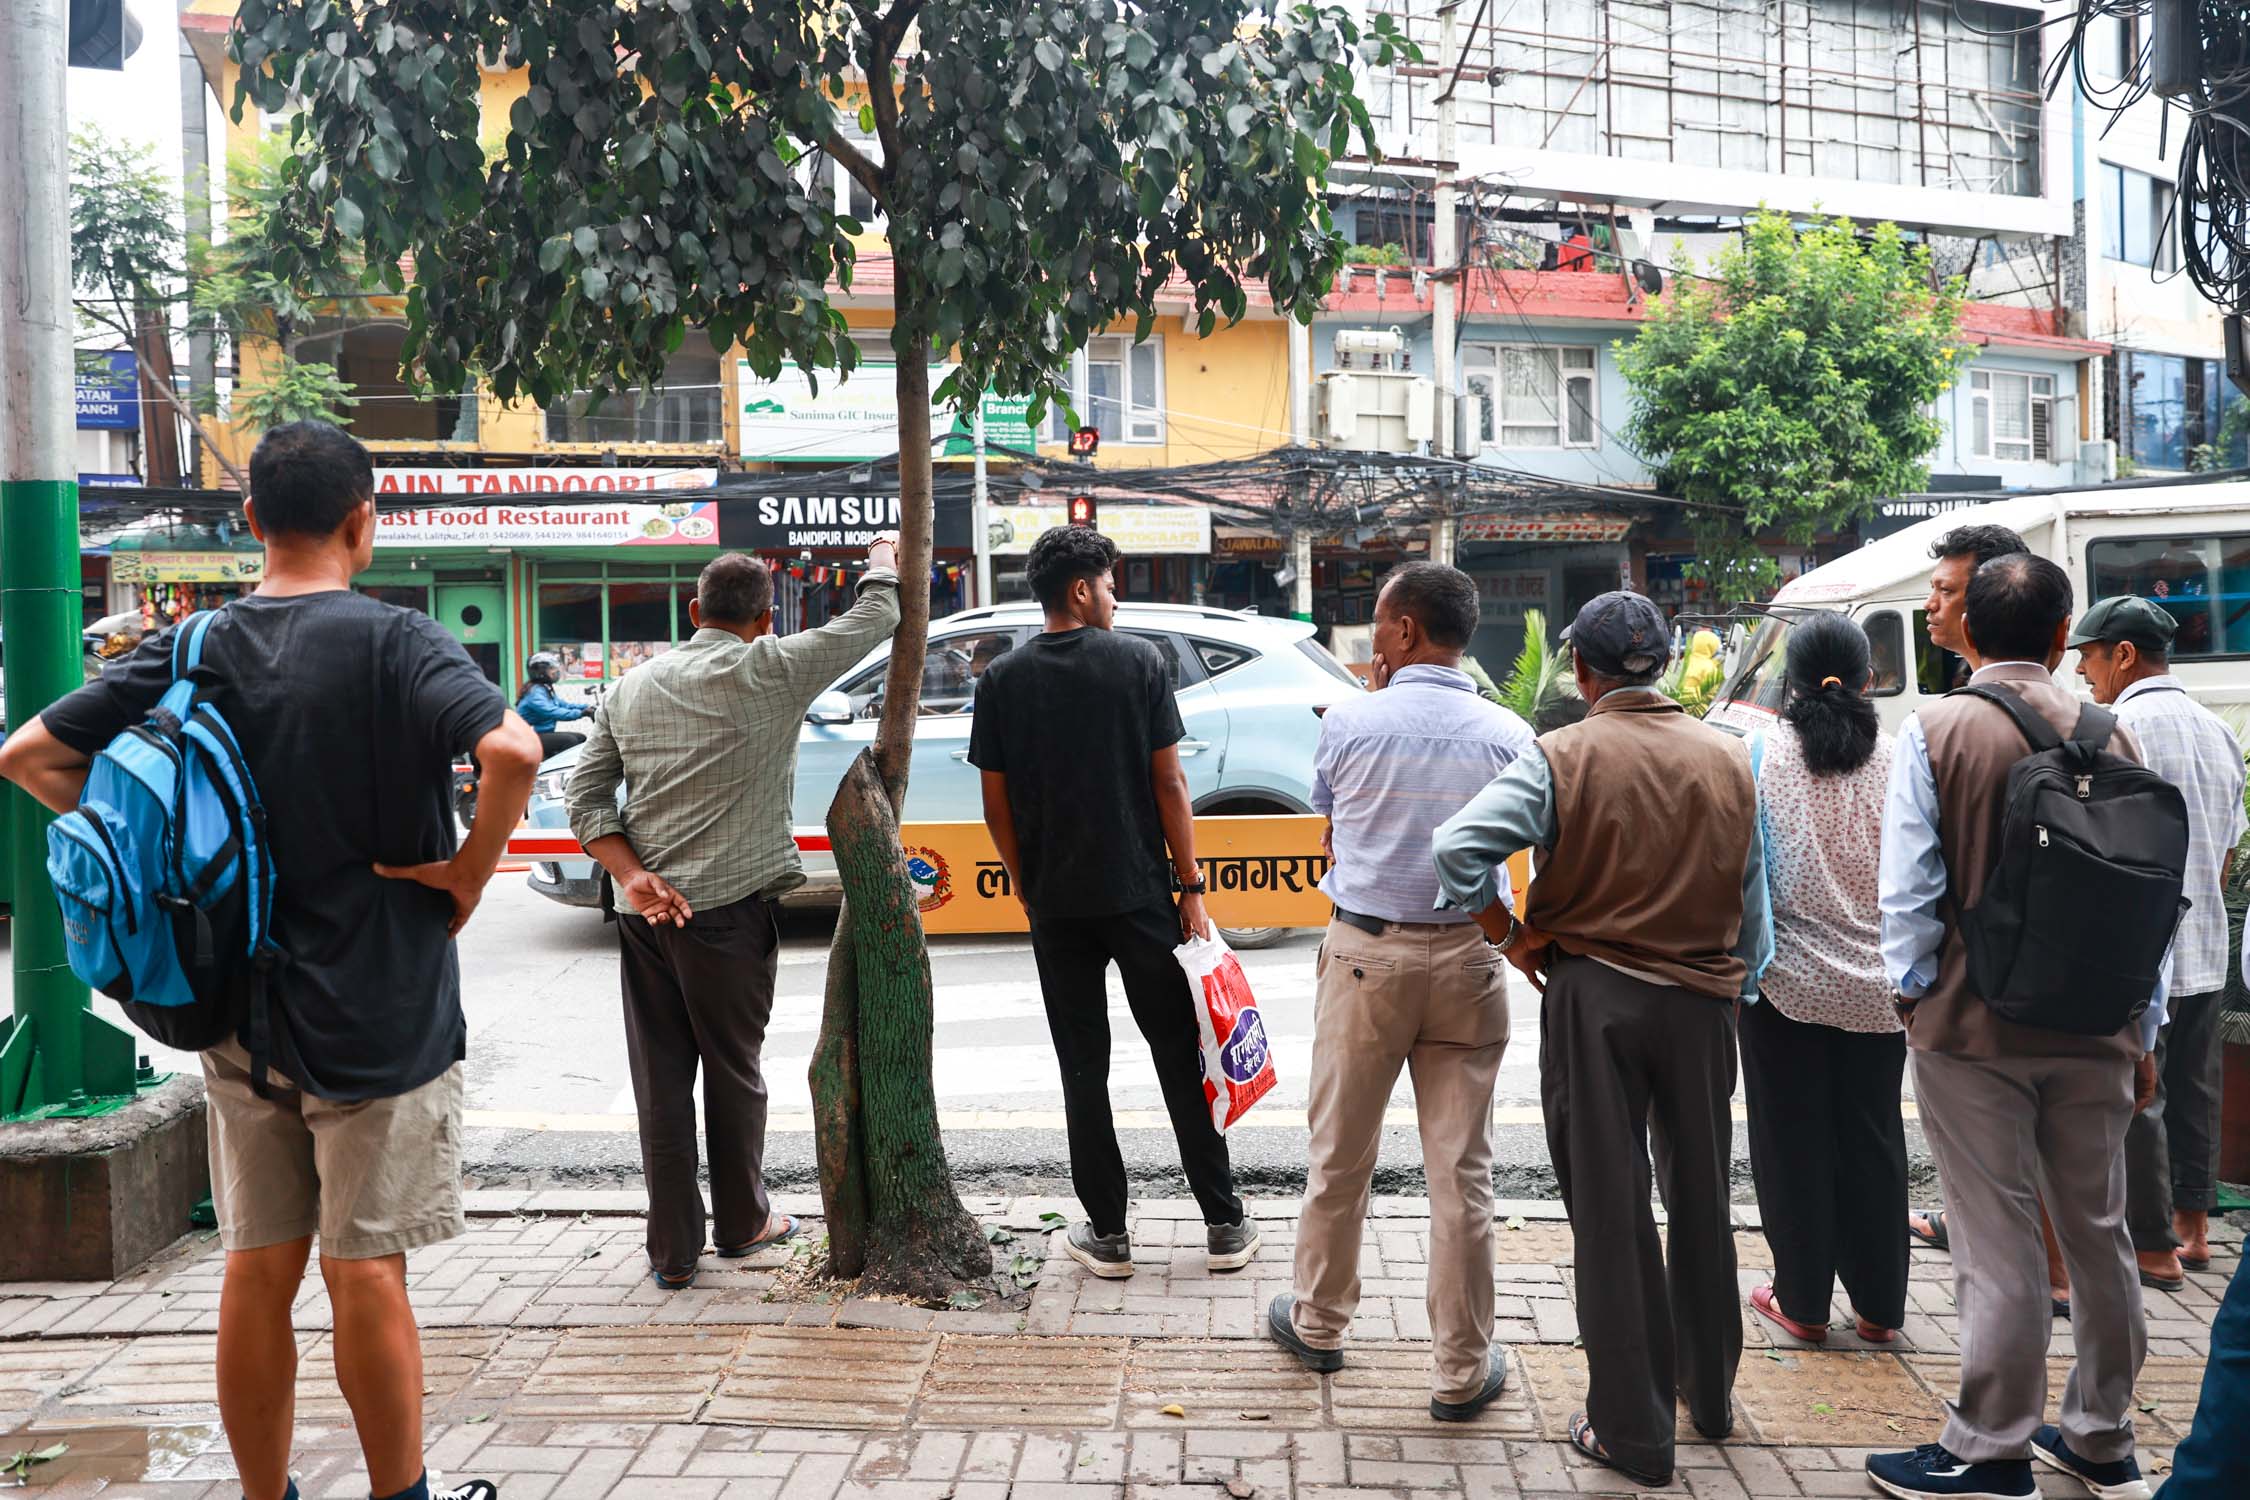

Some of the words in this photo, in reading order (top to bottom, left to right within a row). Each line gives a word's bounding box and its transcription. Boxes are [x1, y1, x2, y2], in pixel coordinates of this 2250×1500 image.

[76, 390, 112, 401] ATAN
[76, 404, 119, 415] RANCH
[789, 409, 836, 421] Sanima
[838, 409, 860, 421] GIC
[427, 506, 488, 526] Food
[498, 508, 630, 526] Restaurant
[758, 496, 936, 526] SAMSUN
[788, 530, 842, 546] BANDIPUR
